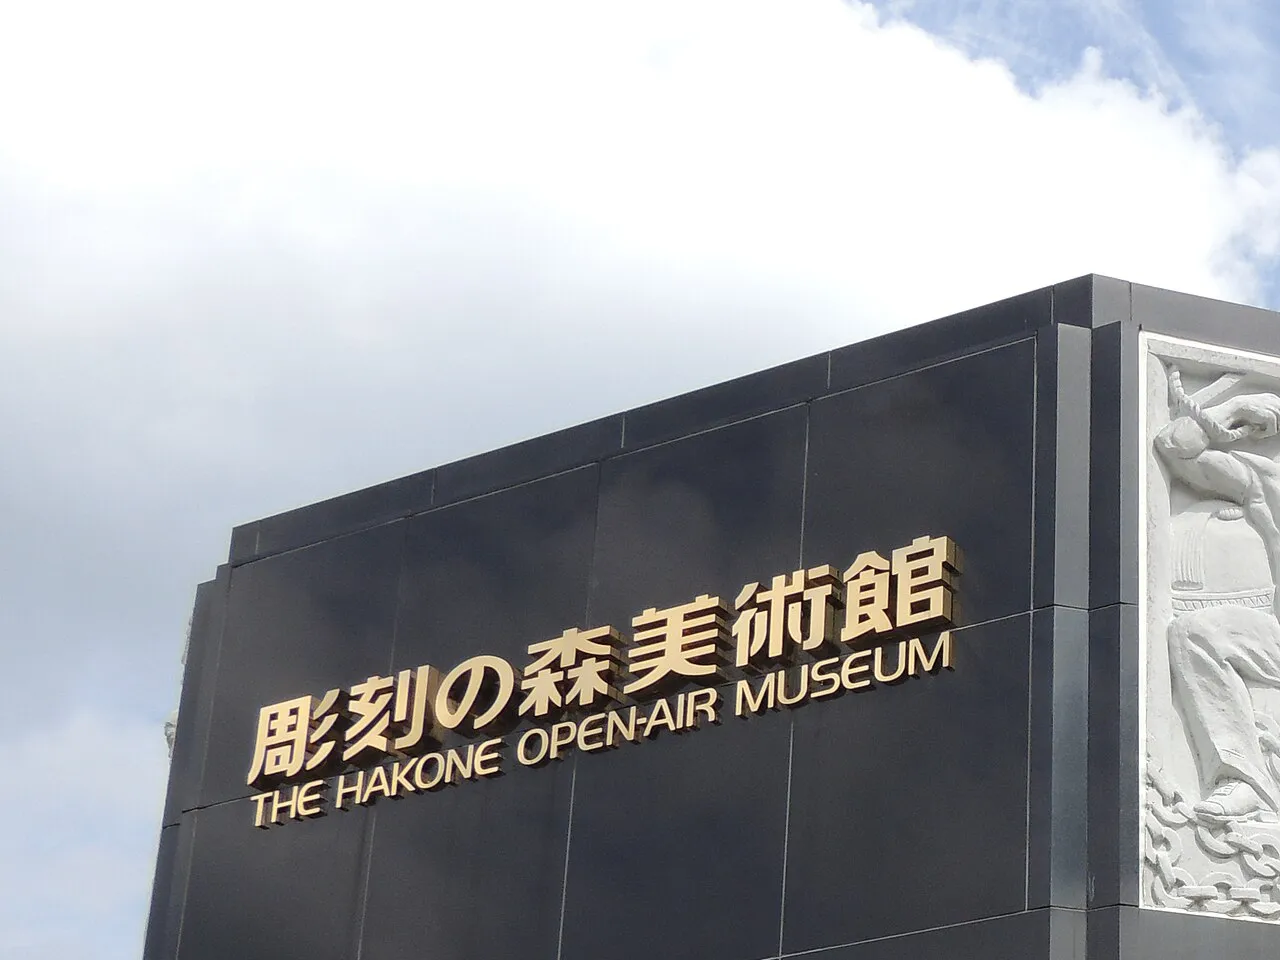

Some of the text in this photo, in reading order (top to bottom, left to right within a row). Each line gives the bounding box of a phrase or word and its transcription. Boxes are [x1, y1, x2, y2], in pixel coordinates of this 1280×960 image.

[247, 535, 954, 785] 彫刻の森美術館
[250, 631, 951, 828] THE HAKONE OPEN-AIR MUSEUM
